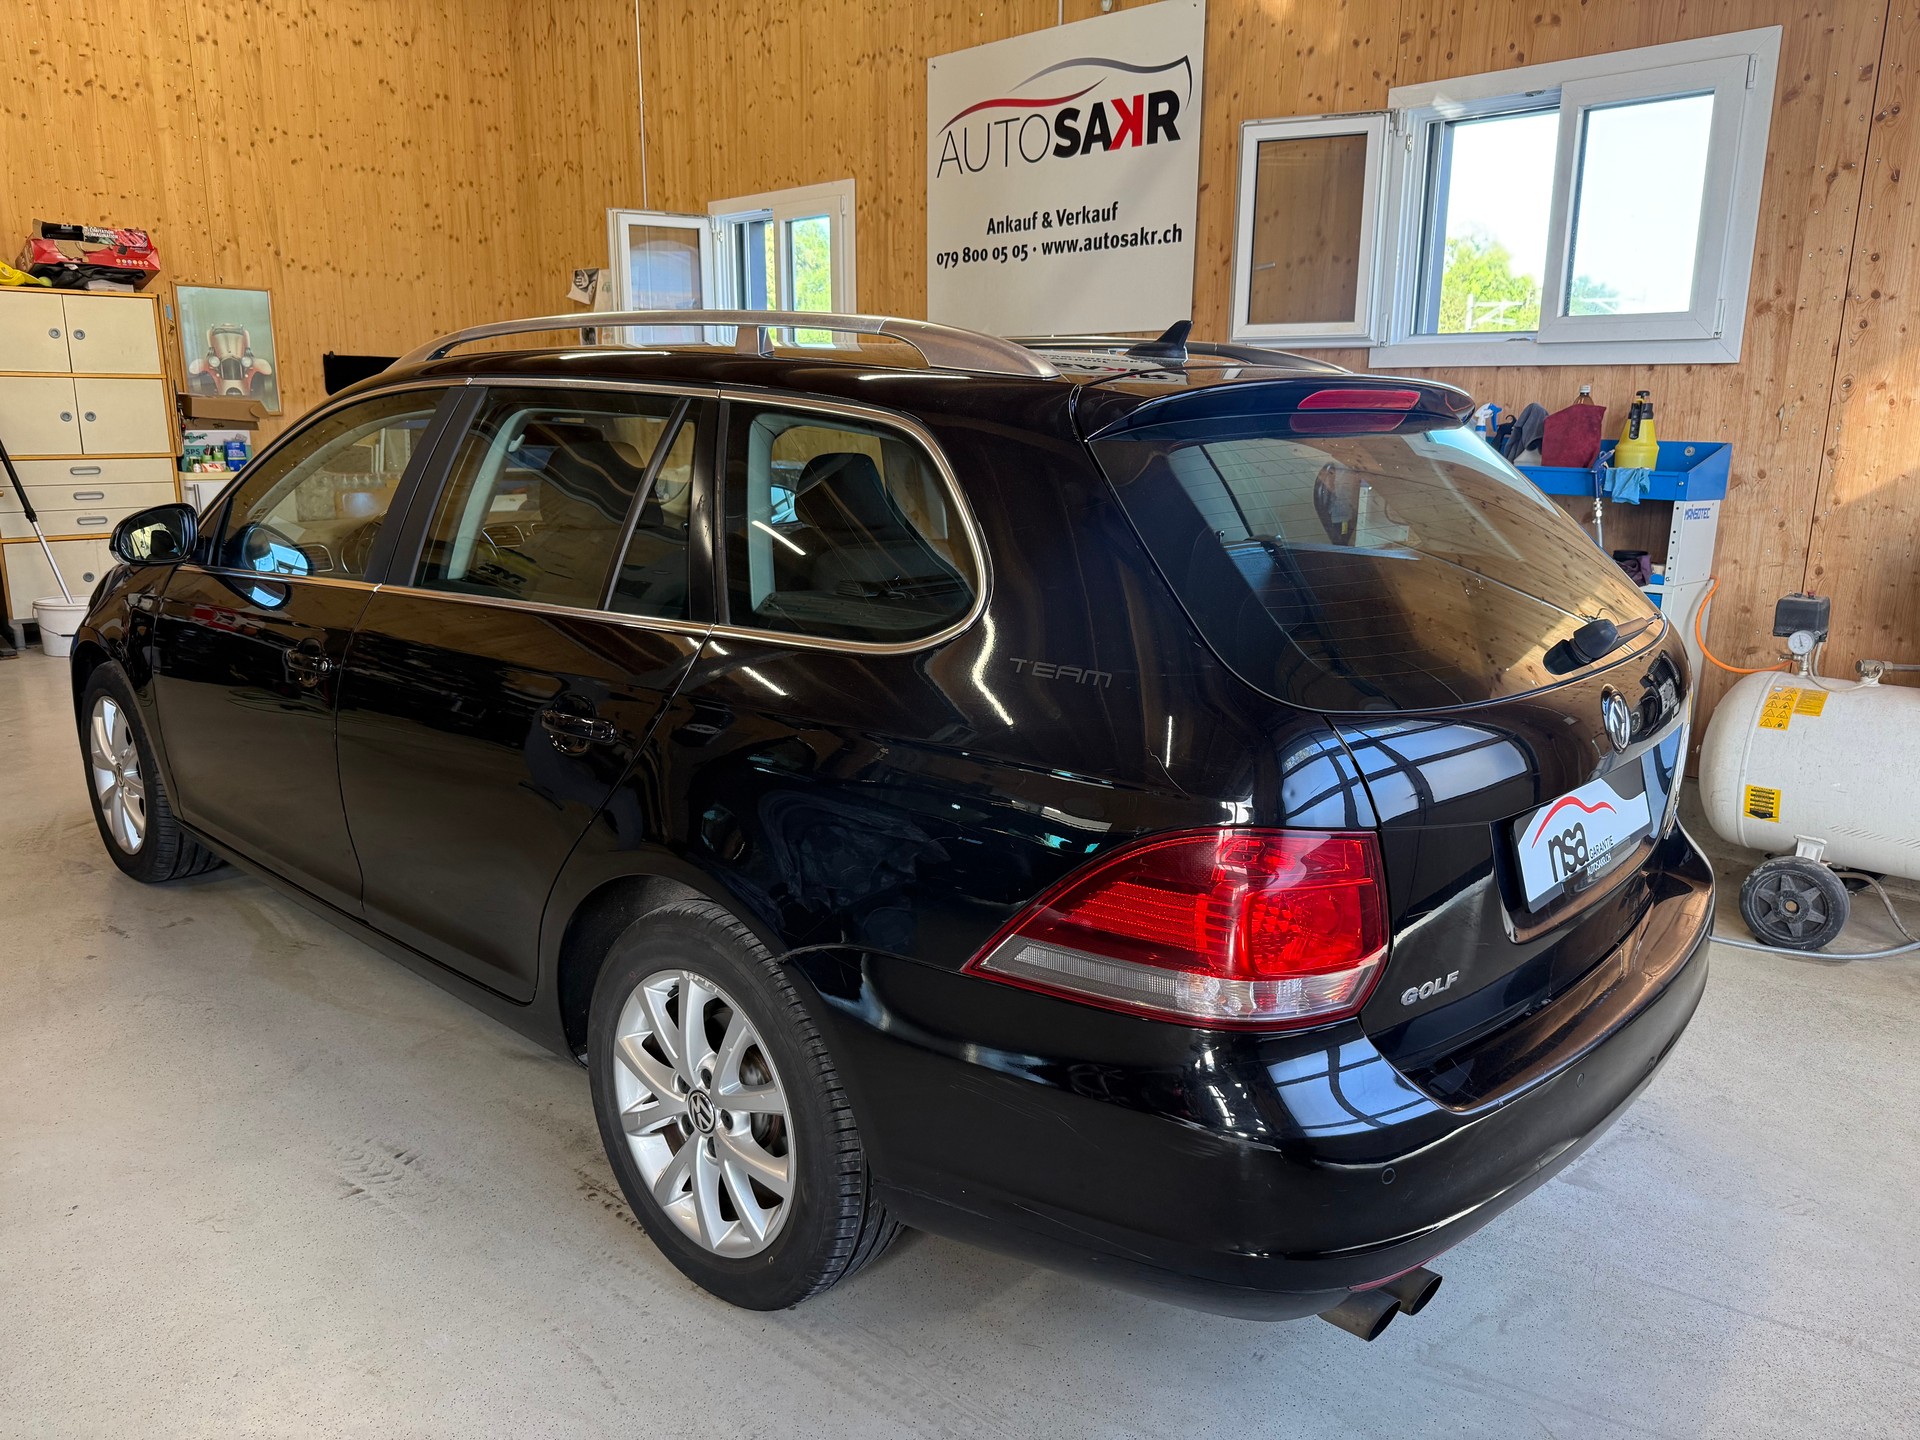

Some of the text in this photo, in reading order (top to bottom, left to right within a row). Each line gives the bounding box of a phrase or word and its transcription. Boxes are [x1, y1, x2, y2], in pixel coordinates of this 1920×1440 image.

[986, 201, 1119, 236] Ankauf & Verkauf
[936, 251, 959, 269] 079
[962, 246, 988, 264] 800
[992, 246, 1008, 264] 05
[1012, 244, 1029, 261] 05
[1041, 223, 1182, 256] www.autosakr.ch
[1009, 657, 1113, 688] TEAM
[1548, 822, 1590, 883] nsa
[1588, 835, 1614, 859] GARANTIE
[1400, 970, 1460, 1006] GOLF
